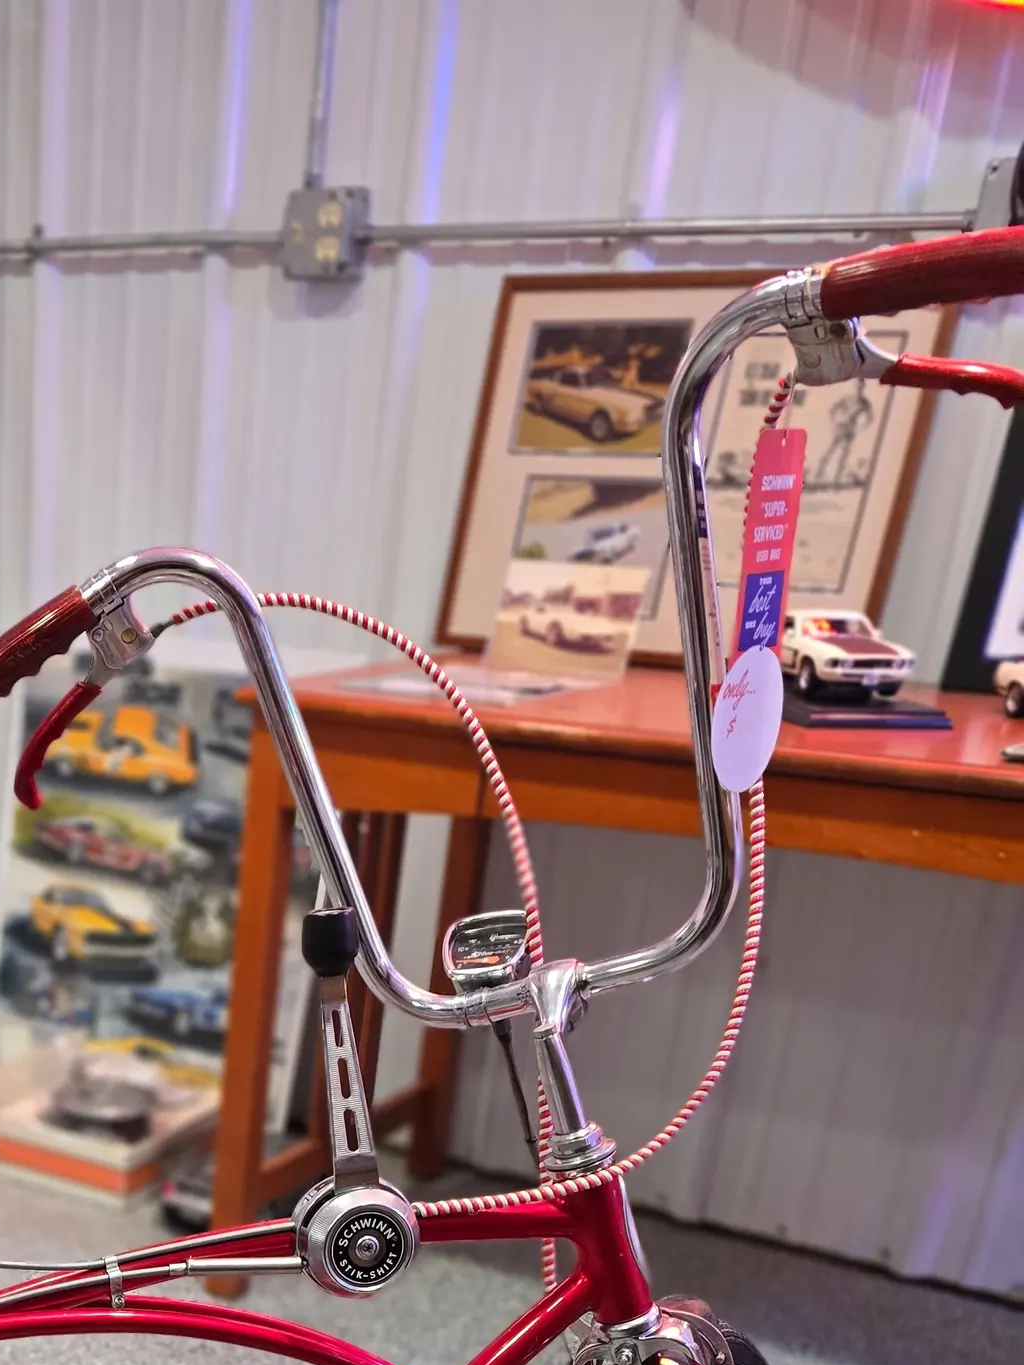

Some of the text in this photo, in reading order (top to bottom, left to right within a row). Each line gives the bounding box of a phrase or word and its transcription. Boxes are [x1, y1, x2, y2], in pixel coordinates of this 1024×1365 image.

[761, 474, 795, 491] SCHWINN
[748, 585, 776, 613] best
[753, 612, 776, 651] buy
[726, 713, 737, 739] $
[339, 1218, 396, 1247] SCHWINN
[339, 1252, 397, 1279] STIK-SHIFT
